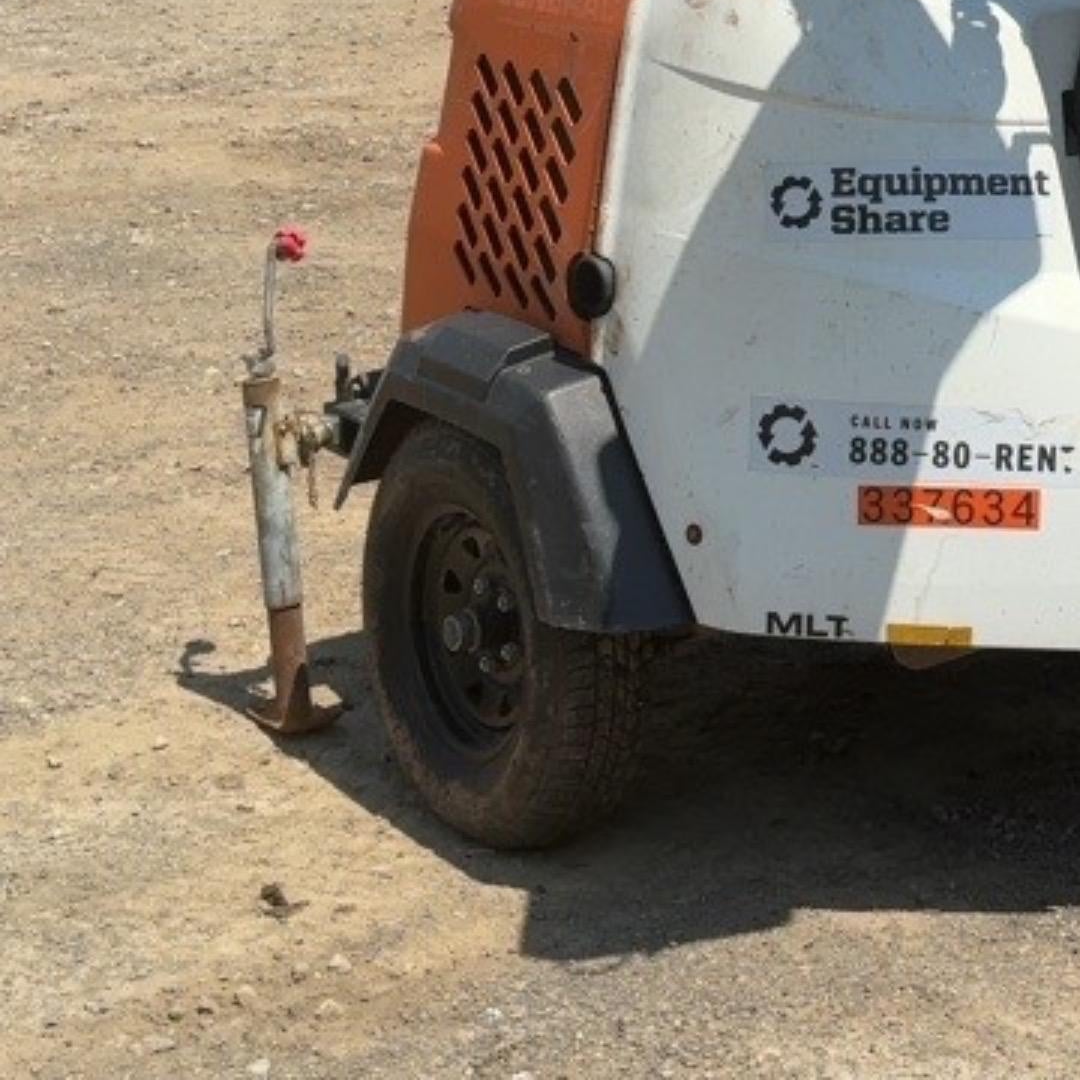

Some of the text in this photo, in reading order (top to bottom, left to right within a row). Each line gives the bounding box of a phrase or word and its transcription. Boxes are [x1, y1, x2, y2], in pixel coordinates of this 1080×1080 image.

[830, 166, 1050, 203] Equipment
[830, 203, 950, 234] Share
[850, 414, 892, 430] CALL
[863, 487, 1035, 526] 337634
